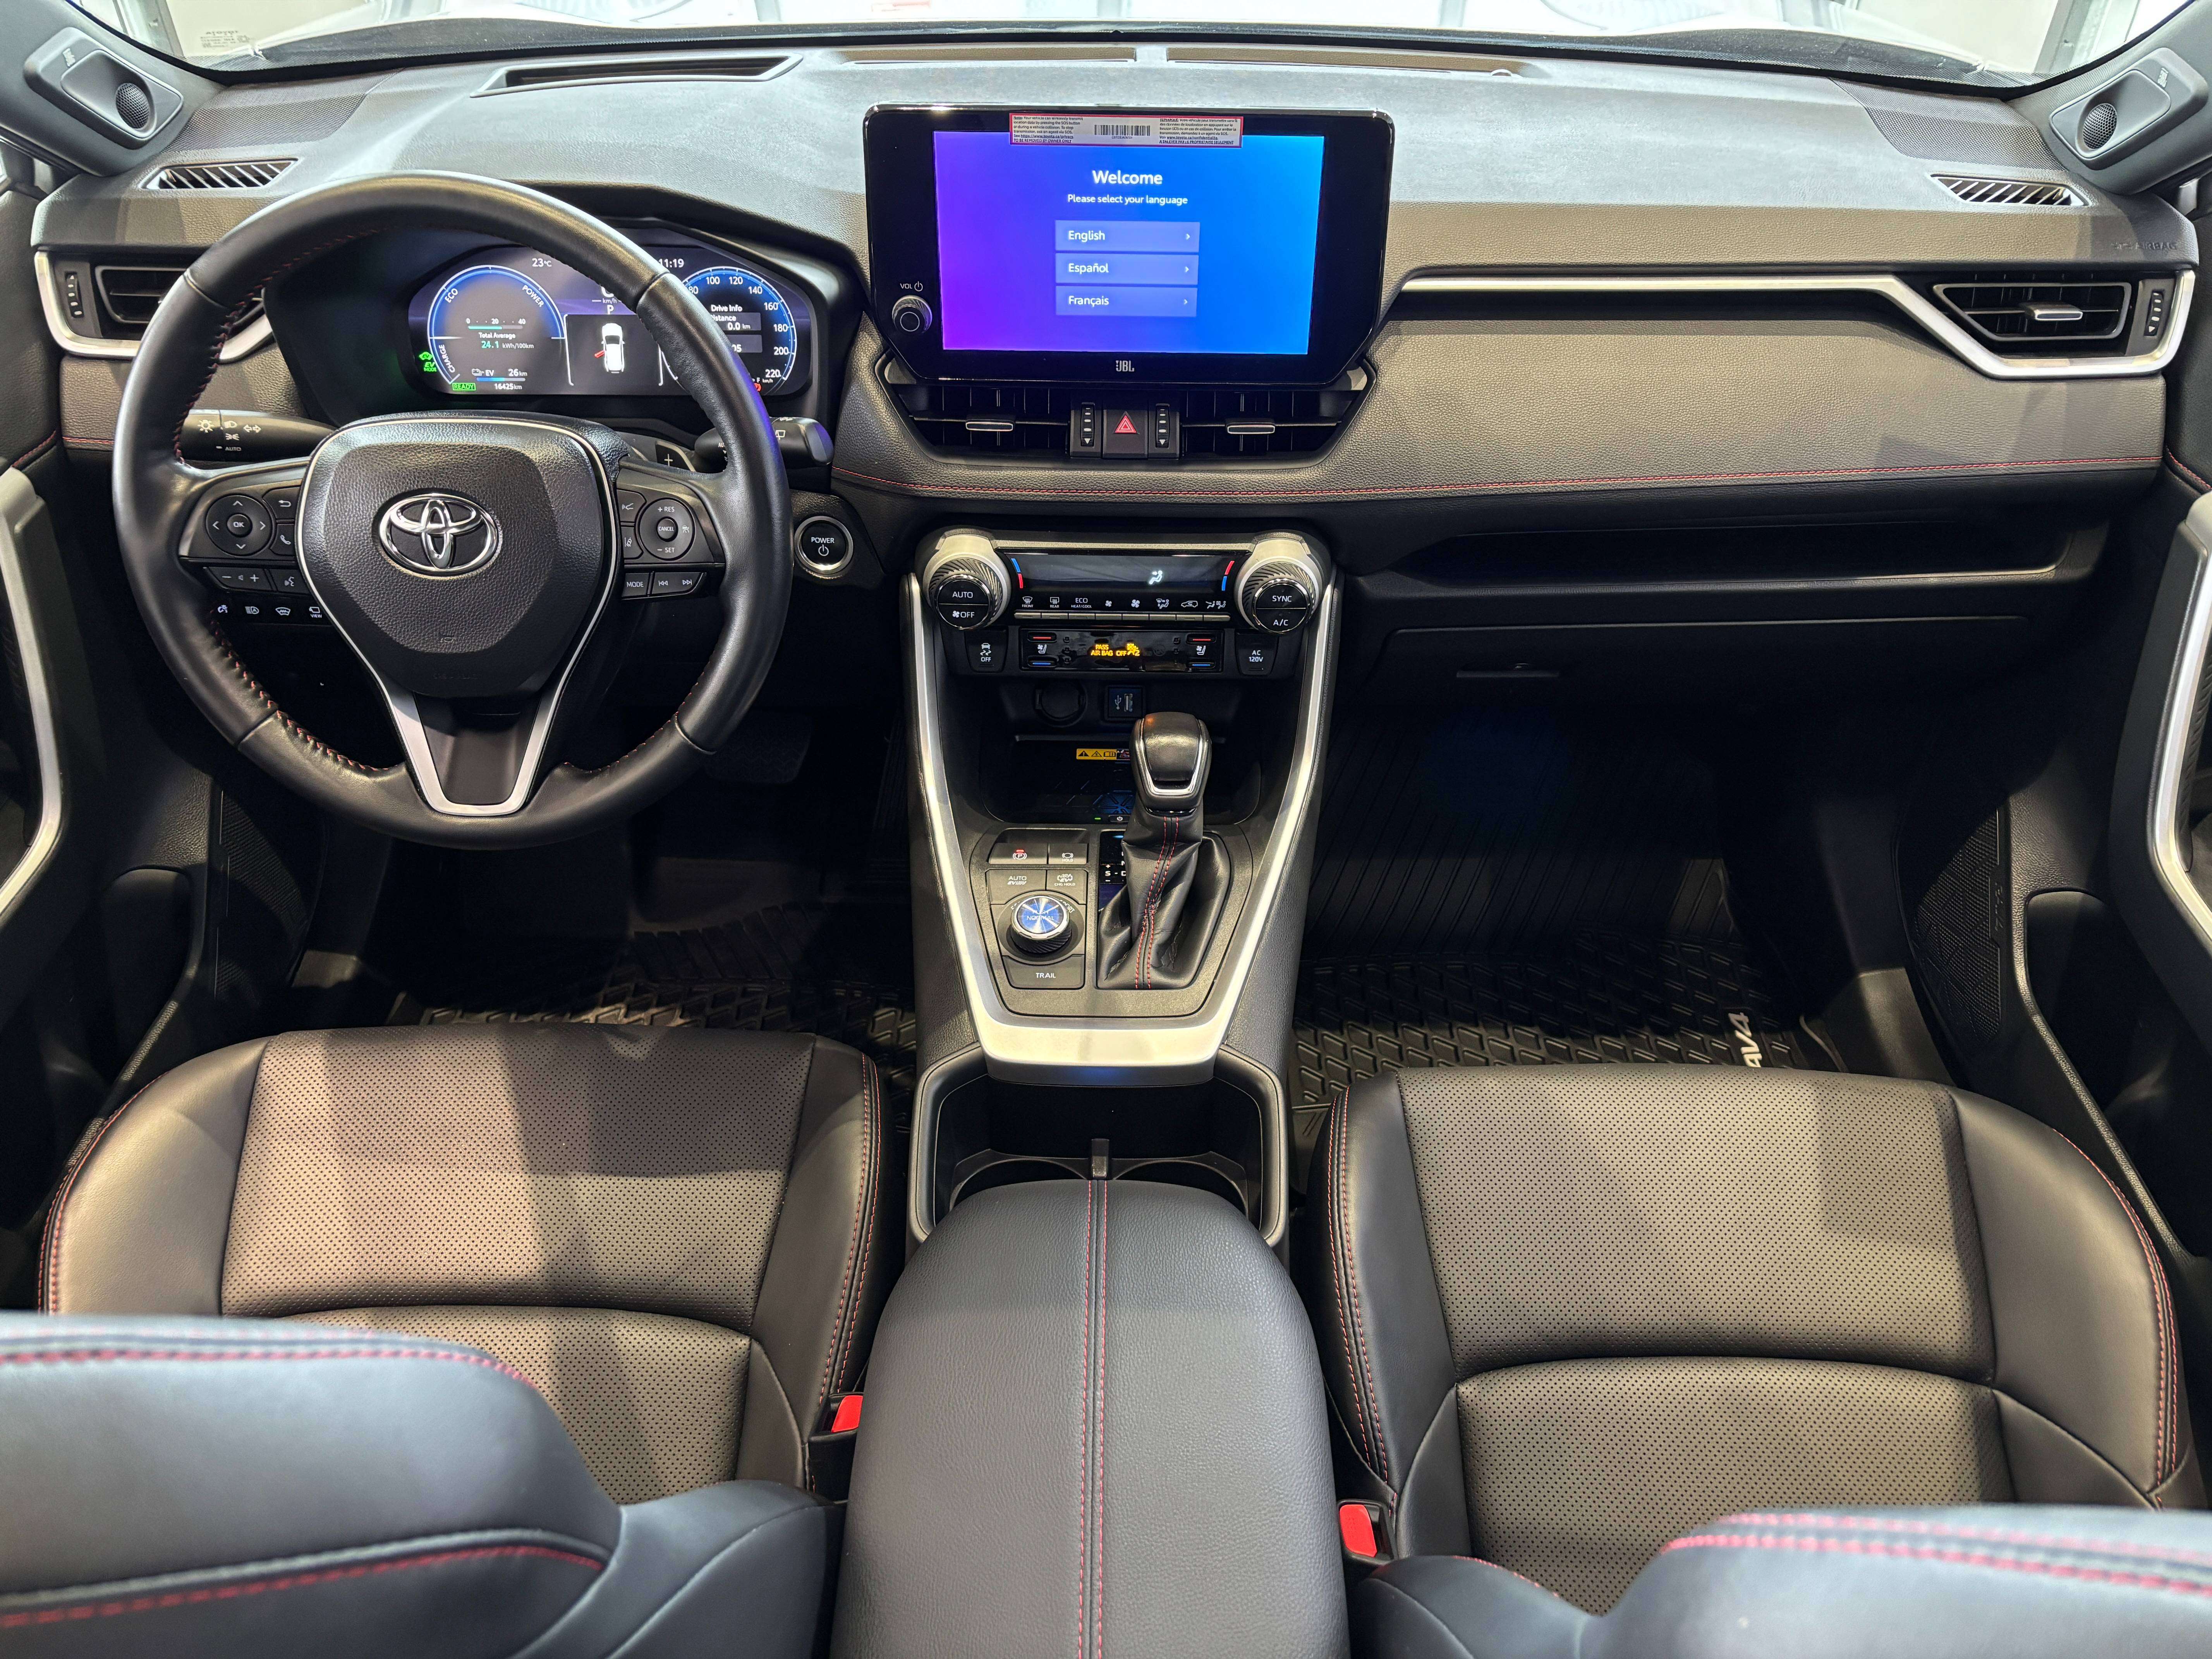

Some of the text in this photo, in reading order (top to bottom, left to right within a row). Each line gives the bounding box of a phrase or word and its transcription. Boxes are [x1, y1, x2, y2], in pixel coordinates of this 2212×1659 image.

[1092, 170, 1163, 184] Welcome
[1068, 194, 1188, 206] Please select your language
[1068, 230, 1105, 242] English
[658, 258, 684, 268] 11:19
[1068, 263, 1109, 274] Español
[706, 276, 720, 285] 100
[729, 276, 743, 285] 120
[688, 286, 699, 294] 80
[748, 286, 763, 294] 140
[445, 288, 459, 303] ECO
[522, 284, 544, 307] POWER
[1068, 295, 1109, 307] Français
[607, 304, 614, 314] P
[764, 302, 778, 311] 160
[728, 322, 740, 330] 0.0
[773, 324, 787, 332] 180
[774, 347, 788, 355] 200
[439, 344, 455, 373] CHARGE
[1115, 360, 1135, 372] JBL
[765, 369, 780, 378] 220
[1728, 1012, 1762, 1068] AV4
